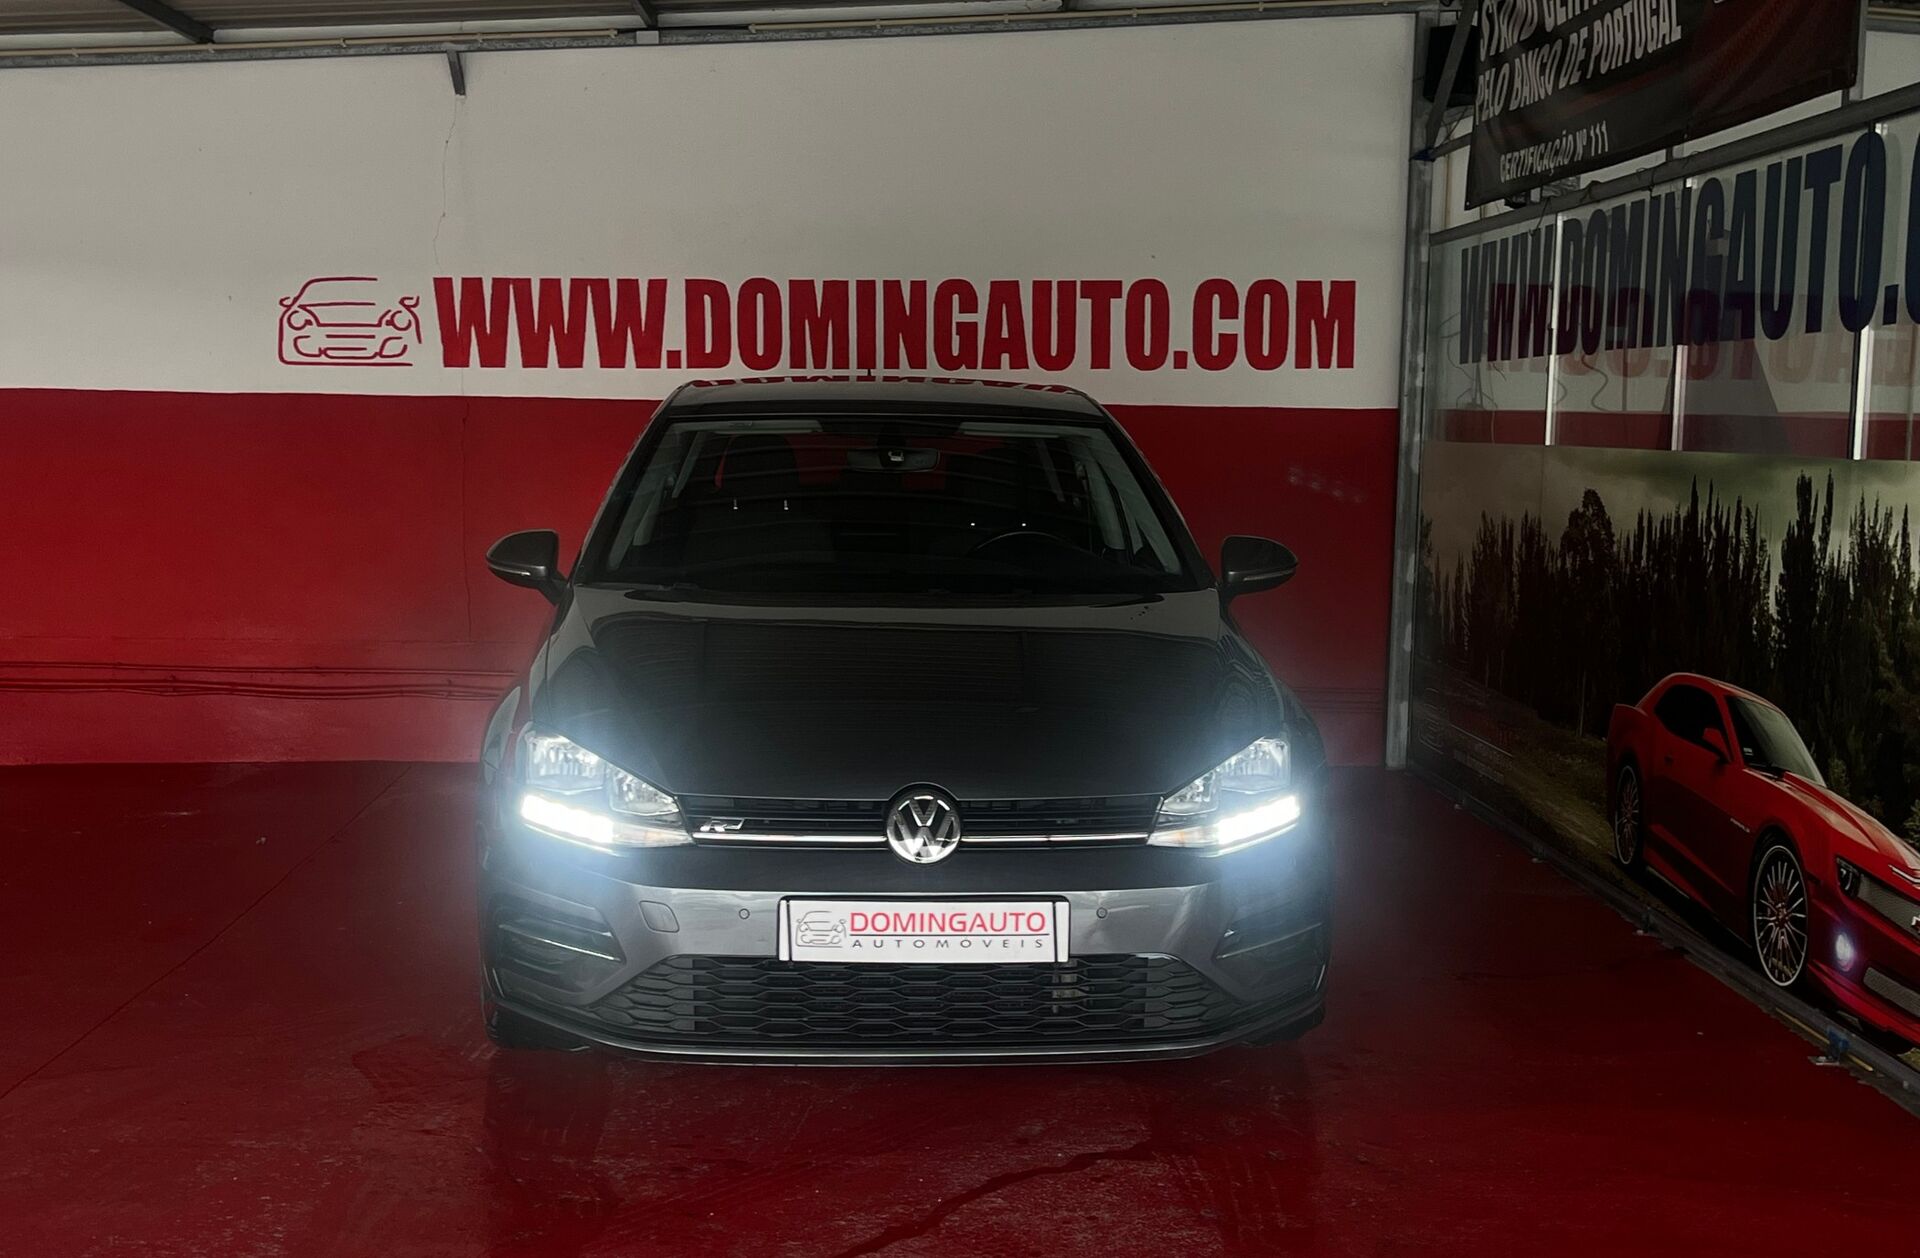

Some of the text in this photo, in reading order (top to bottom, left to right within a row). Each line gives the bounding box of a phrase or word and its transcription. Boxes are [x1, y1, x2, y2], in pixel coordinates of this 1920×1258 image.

[1474, 62, 1510, 126] PELO
[1509, 38, 1563, 111] BANCO
[1558, 26, 1588, 90] DE
[1585, 0, 1682, 79] PORTUGAL
[1500, 129, 1574, 183] CERTIFICAÇÃO
[1590, 119, 1608, 157] 111
[432, 277, 1357, 371] WWW.DOMINGAUTO.COM
[850, 912, 1046, 932] DOMINGAUTO
[852, 936, 1043, 948] AUTOMÓVEIS
